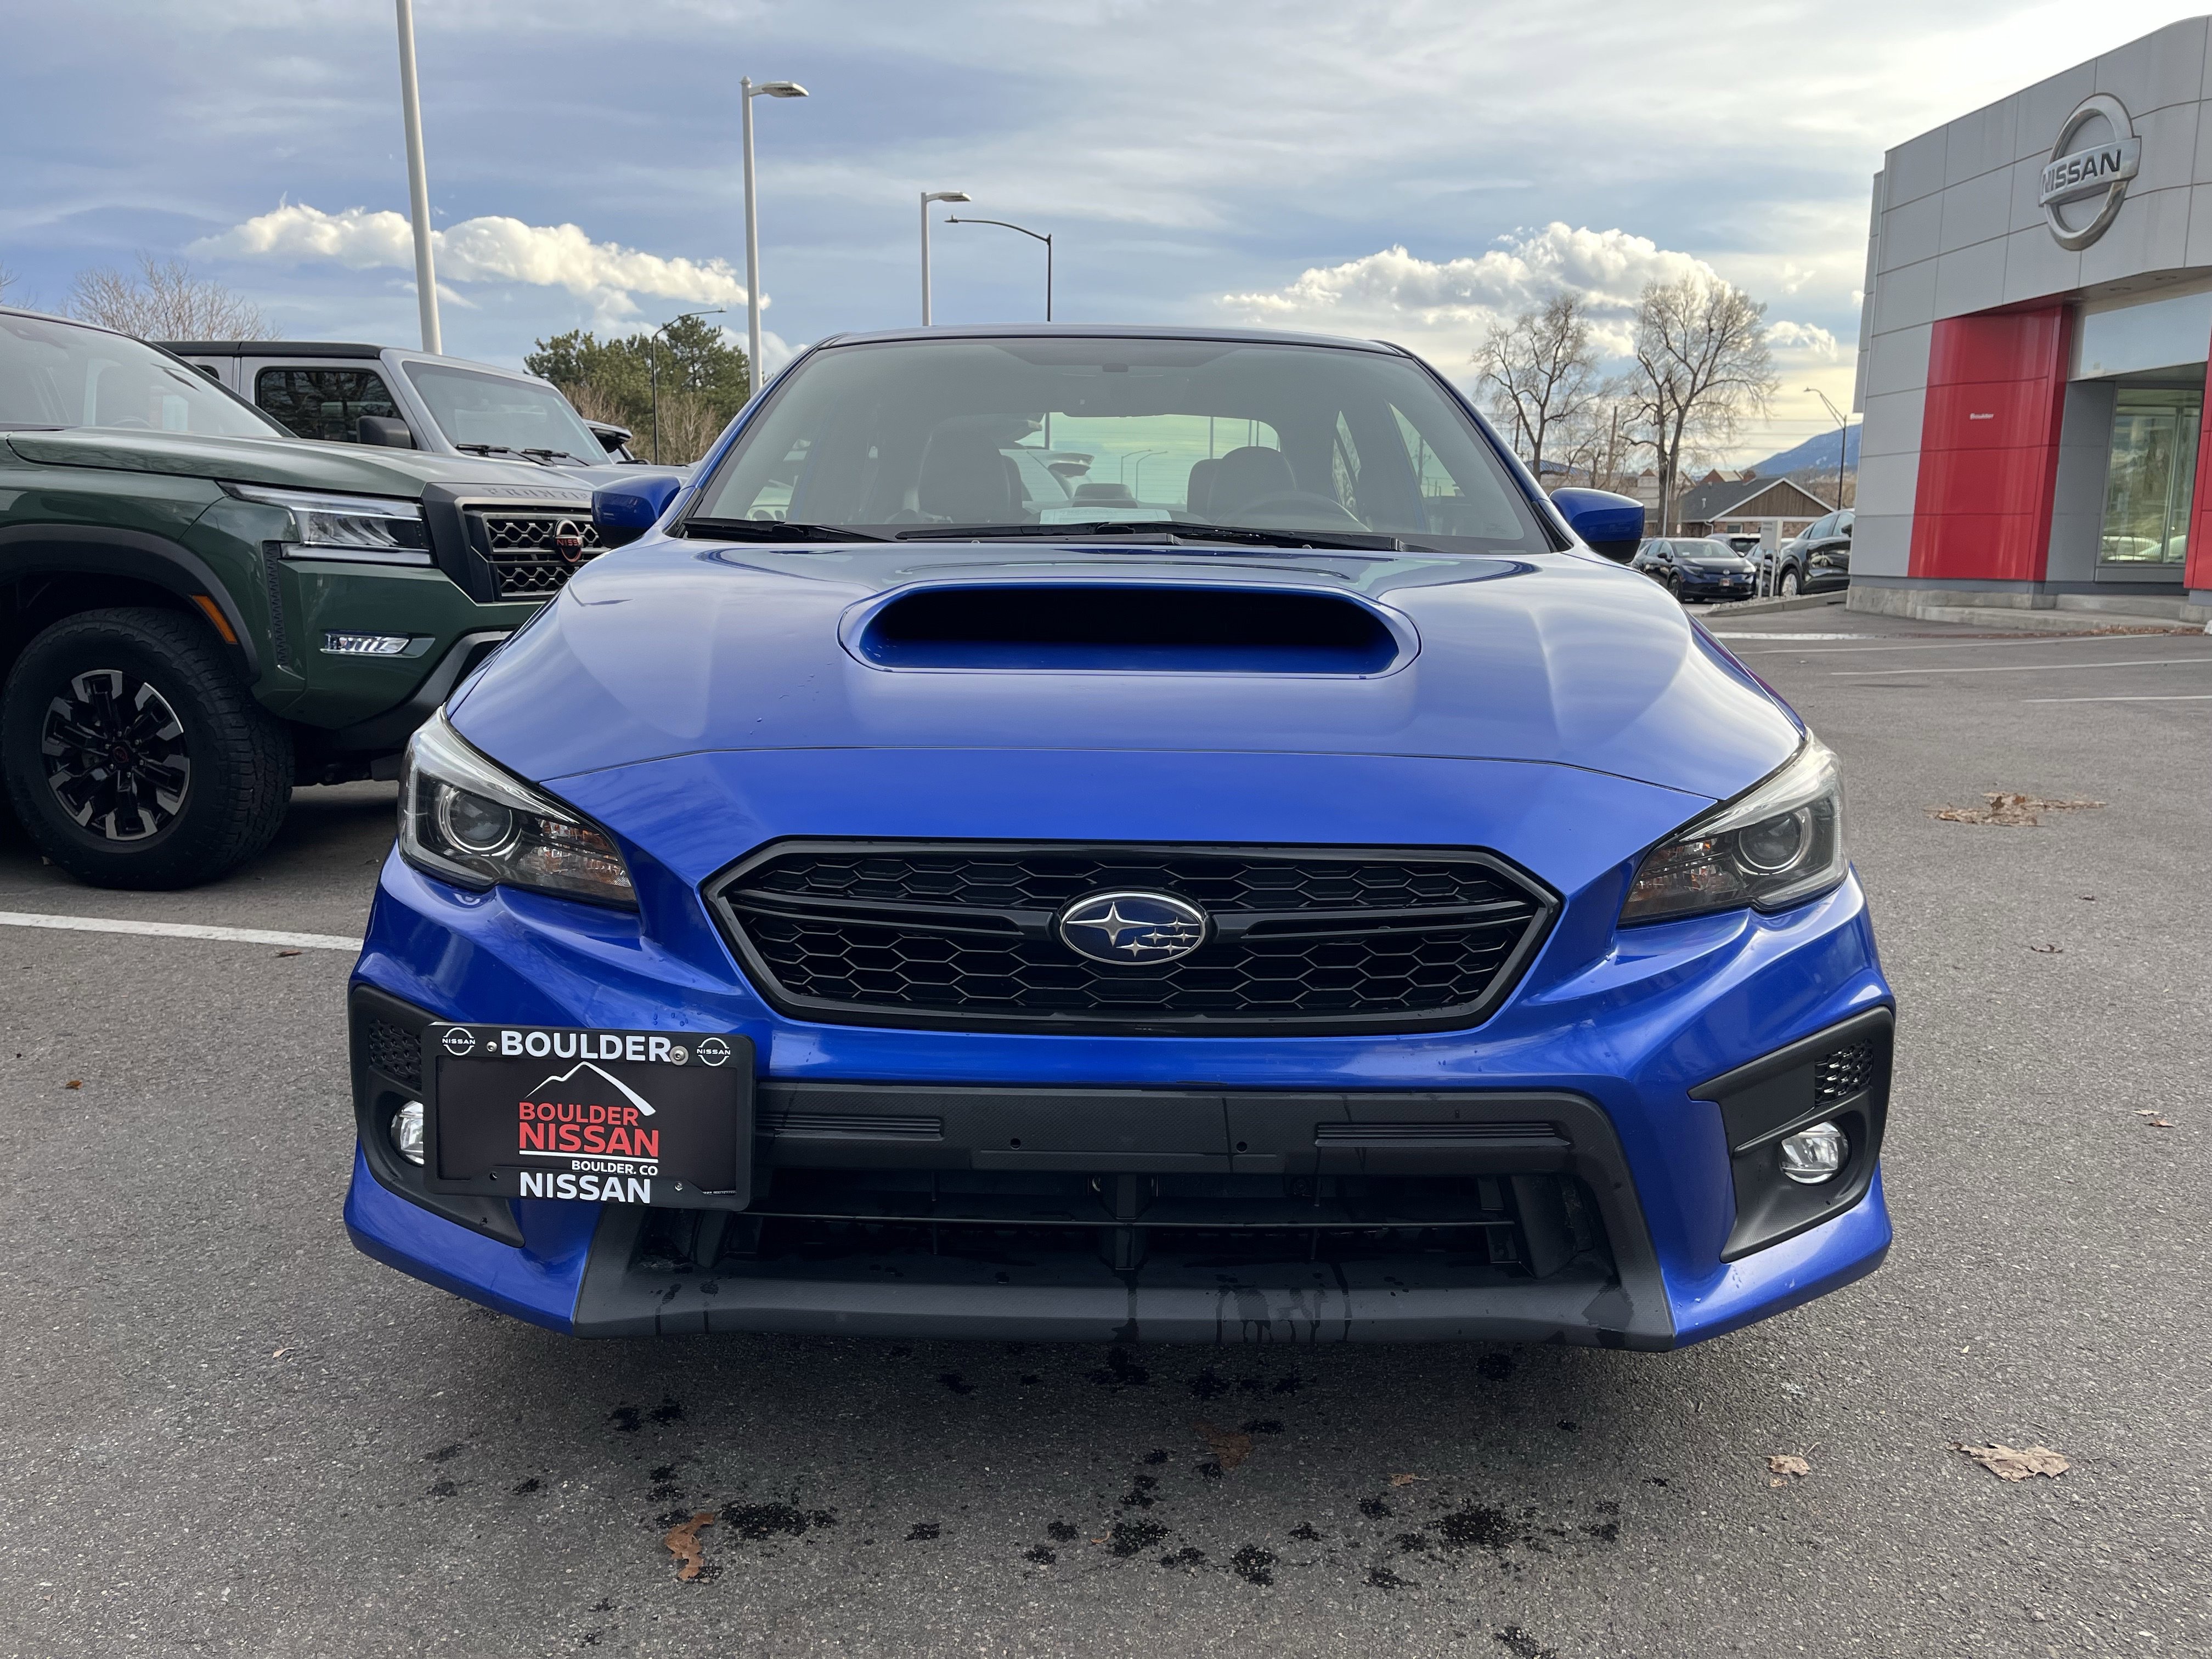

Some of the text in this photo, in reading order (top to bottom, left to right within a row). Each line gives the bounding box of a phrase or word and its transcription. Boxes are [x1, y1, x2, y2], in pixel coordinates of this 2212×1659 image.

[2041, 149, 2122, 196] NISSAN
[501, 1031, 672, 1063] BOULDER
[519, 1102, 639, 1126] BOULDER
[519, 1122, 658, 1157] NISSAN
[639, 1165, 658, 1176] CO
[520, 1172, 651, 1204] NISSAN
